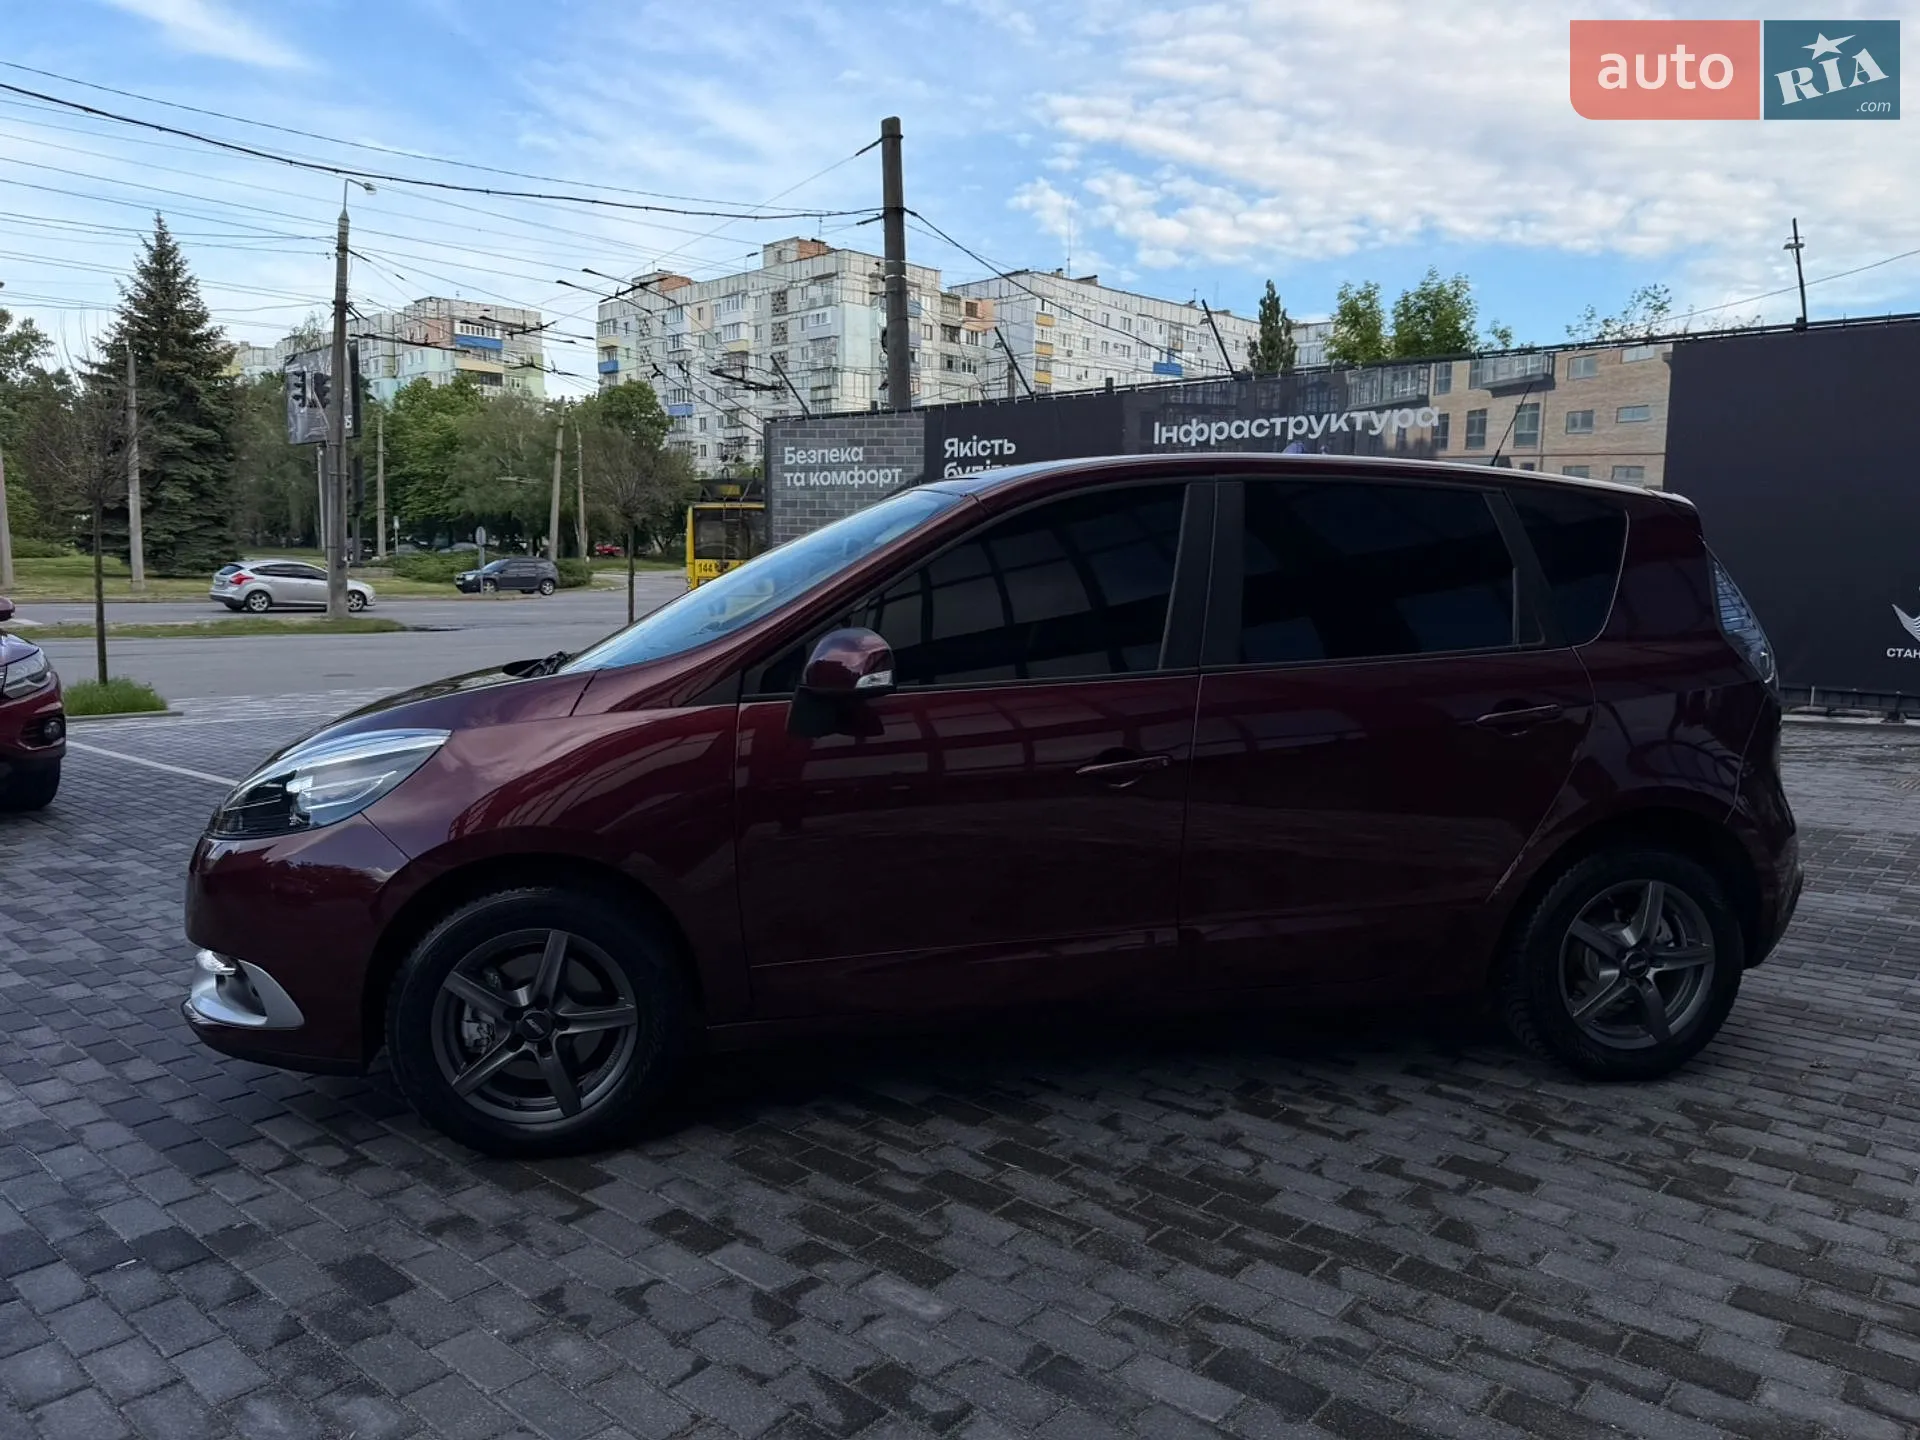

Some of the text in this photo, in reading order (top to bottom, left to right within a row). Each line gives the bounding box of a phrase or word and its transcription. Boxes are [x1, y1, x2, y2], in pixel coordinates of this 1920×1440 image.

[1153, 406, 1440, 446] Інфраструктура
[783, 446, 864, 466] Безпека
[943, 434, 1017, 459] Якість
[784, 467, 903, 489] та комфорт
